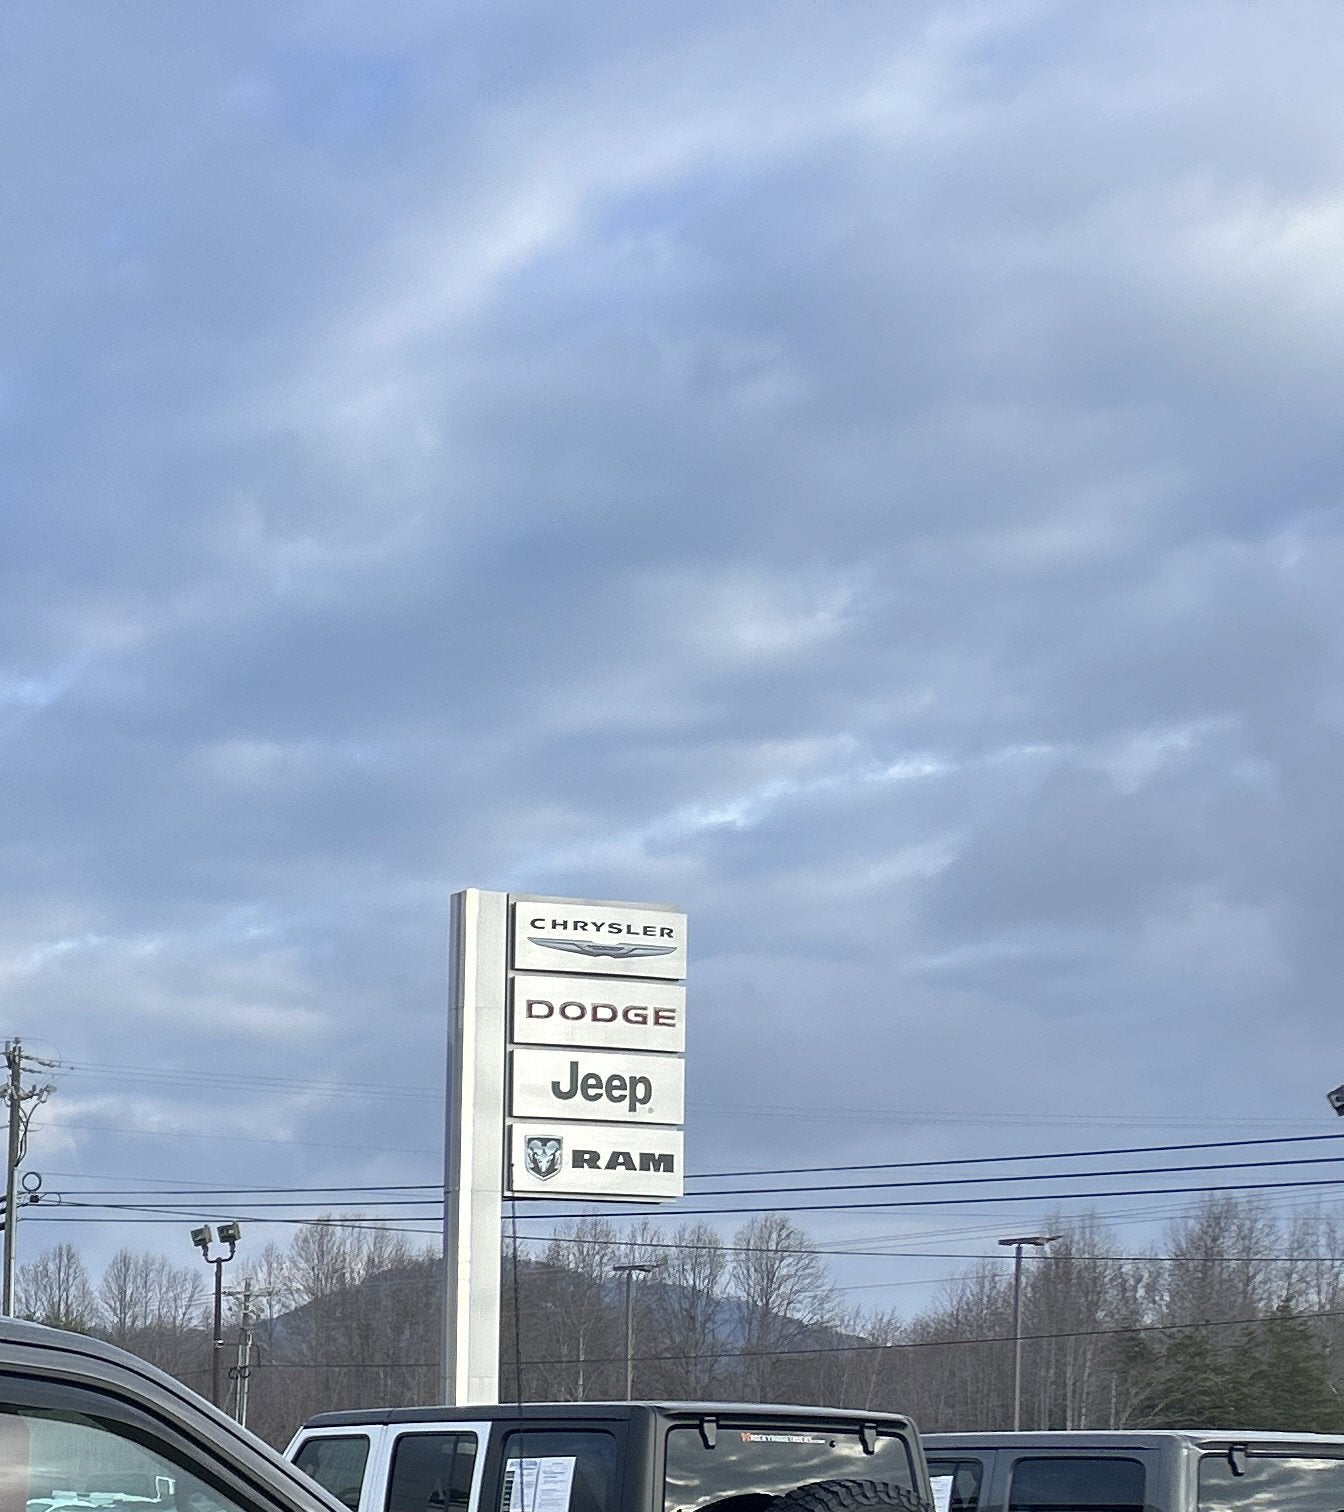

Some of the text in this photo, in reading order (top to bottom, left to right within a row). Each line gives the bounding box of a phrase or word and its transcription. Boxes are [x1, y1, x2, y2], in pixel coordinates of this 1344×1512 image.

[530, 918, 675, 939] CHRYSLER
[525, 999, 677, 1028] DODGE
[551, 1061, 653, 1113] Jeep
[571, 1149, 675, 1174] RAM
